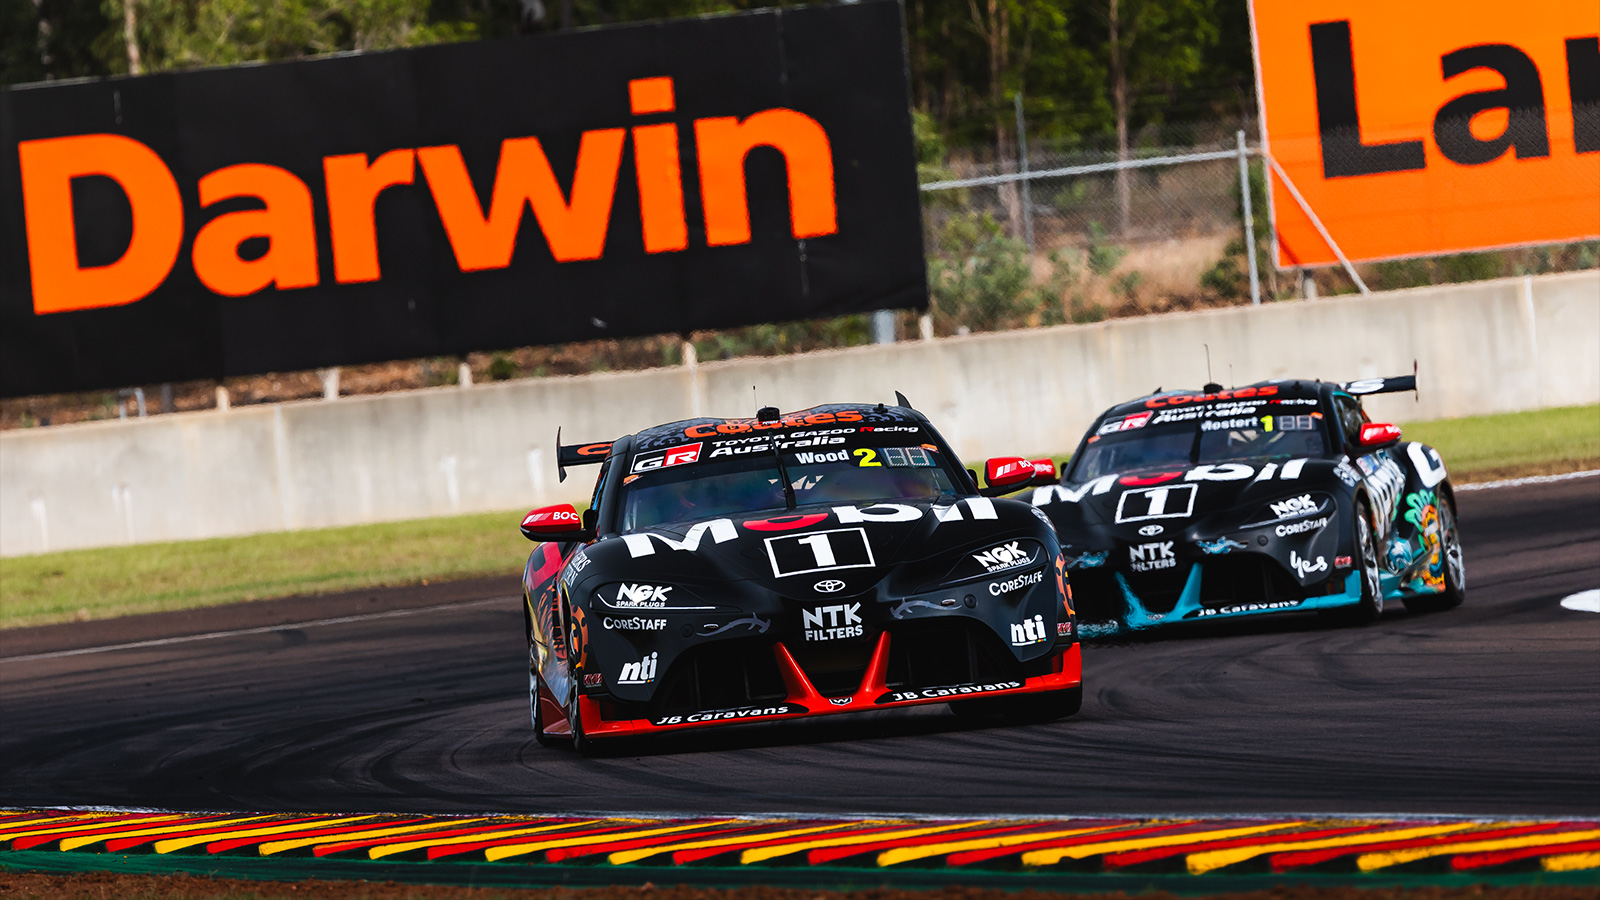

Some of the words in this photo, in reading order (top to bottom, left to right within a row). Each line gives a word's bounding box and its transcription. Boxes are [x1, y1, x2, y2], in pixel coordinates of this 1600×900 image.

[18, 76, 838, 316] Darwin
[1158, 403, 1213, 415] TOYOT
[1099, 416, 1147, 436] GR
[1260, 415, 1274, 432] 1
[709, 435, 846, 458] Australia
[711, 433, 785, 448] TOYOTA
[790, 427, 856, 439] GAZOO
[859, 426, 919, 434] Racing
[633, 450, 698, 472] GR
[794, 449, 850, 464] Wood
[852, 448, 882, 467] 2
[1031, 457, 1309, 507] Mobil
[1143, 488, 1170, 516] 1
[552, 511, 579, 521] BOC
[619, 497, 998, 559] Mobil
[797, 533, 837, 568] 1
[972, 541, 1027, 568] NGK
[1128, 540, 1175, 562] NTK
[986, 562, 1010, 573] SPARK
[1009, 556, 1031, 567] PLUGS
[616, 582, 673, 603] NGK
[615, 600, 638, 608] SPARK
[802, 601, 863, 630] NTK
[804, 624, 864, 642] FILTERS
[1010, 614, 1046, 645] nti
[617, 651, 658, 683] nti
[892, 692, 919, 701] JB
[922, 681, 1021, 698] Caravans
[656, 715, 683, 725] JB
[686, 705, 789, 722] Caravans
